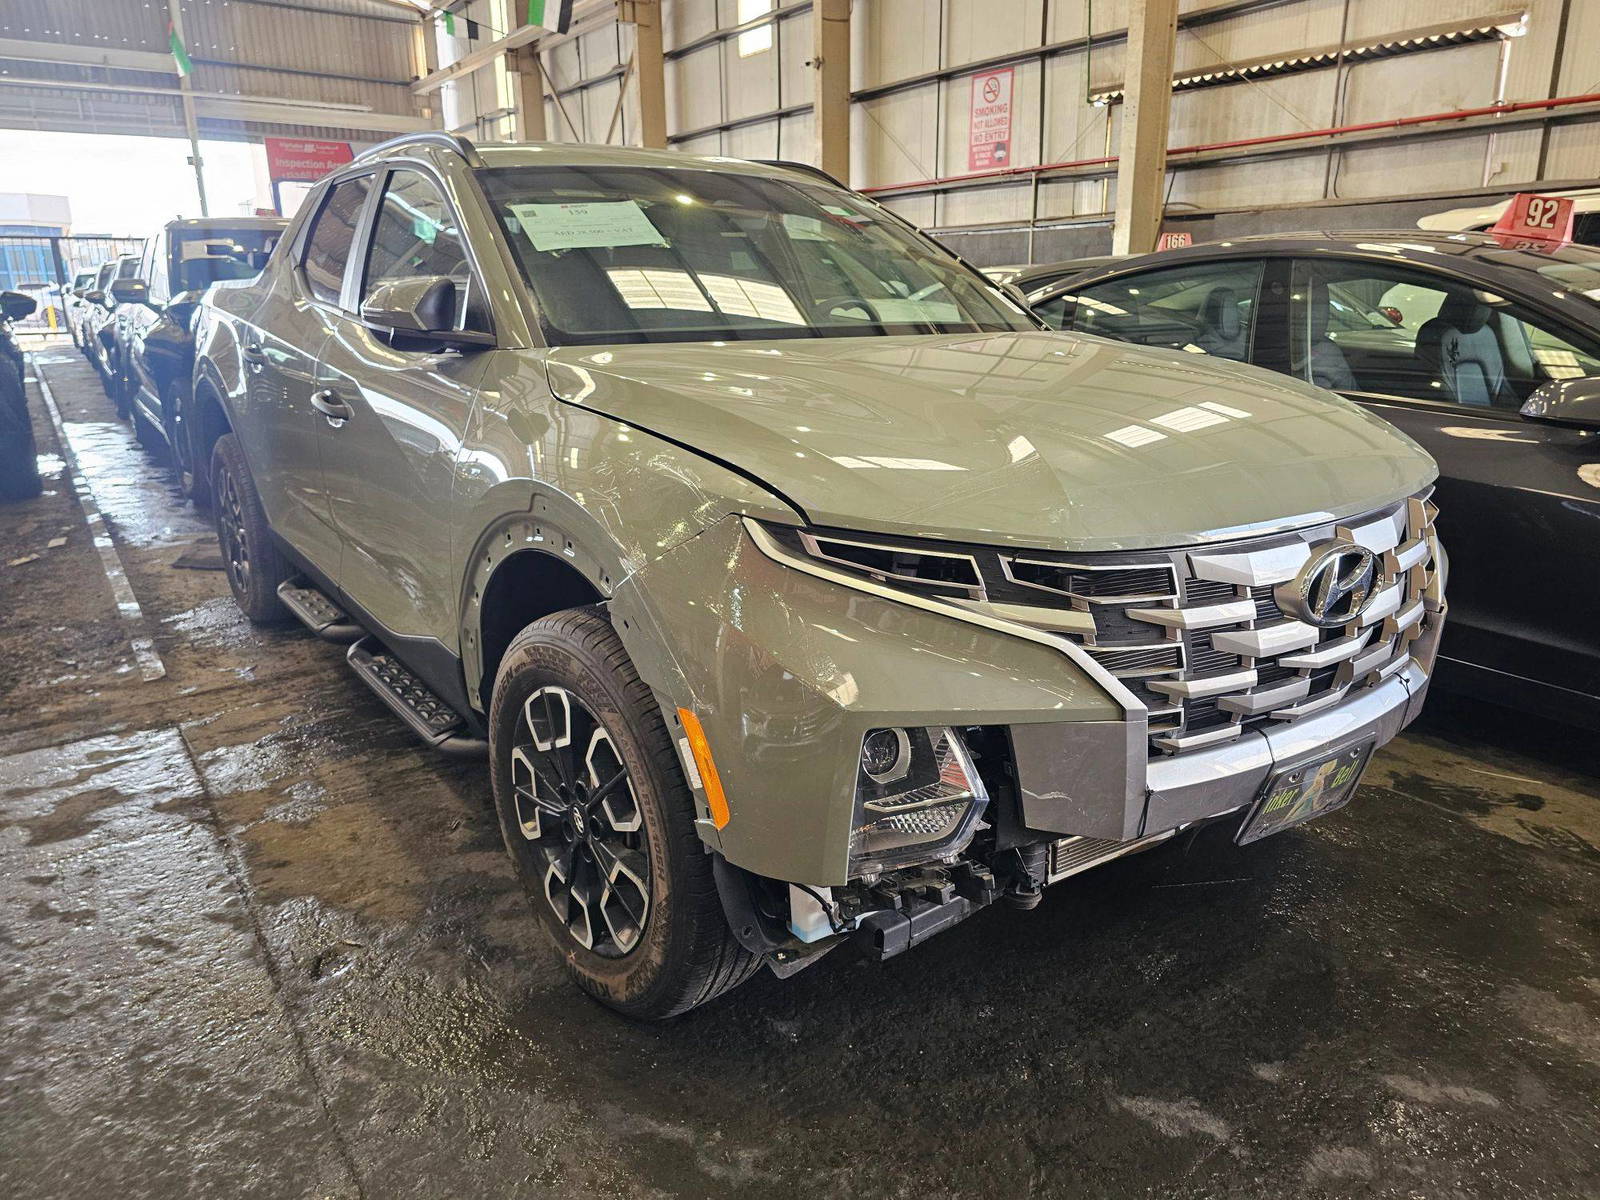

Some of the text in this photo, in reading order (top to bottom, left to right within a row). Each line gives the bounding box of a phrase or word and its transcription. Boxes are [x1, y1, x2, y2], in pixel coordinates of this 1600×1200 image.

[974, 103, 1008, 118] SMOKING
[985, 130, 1006, 142] ENTRY
[1526, 198, 1559, 228] 92
[1166, 234, 1185, 248] 166
